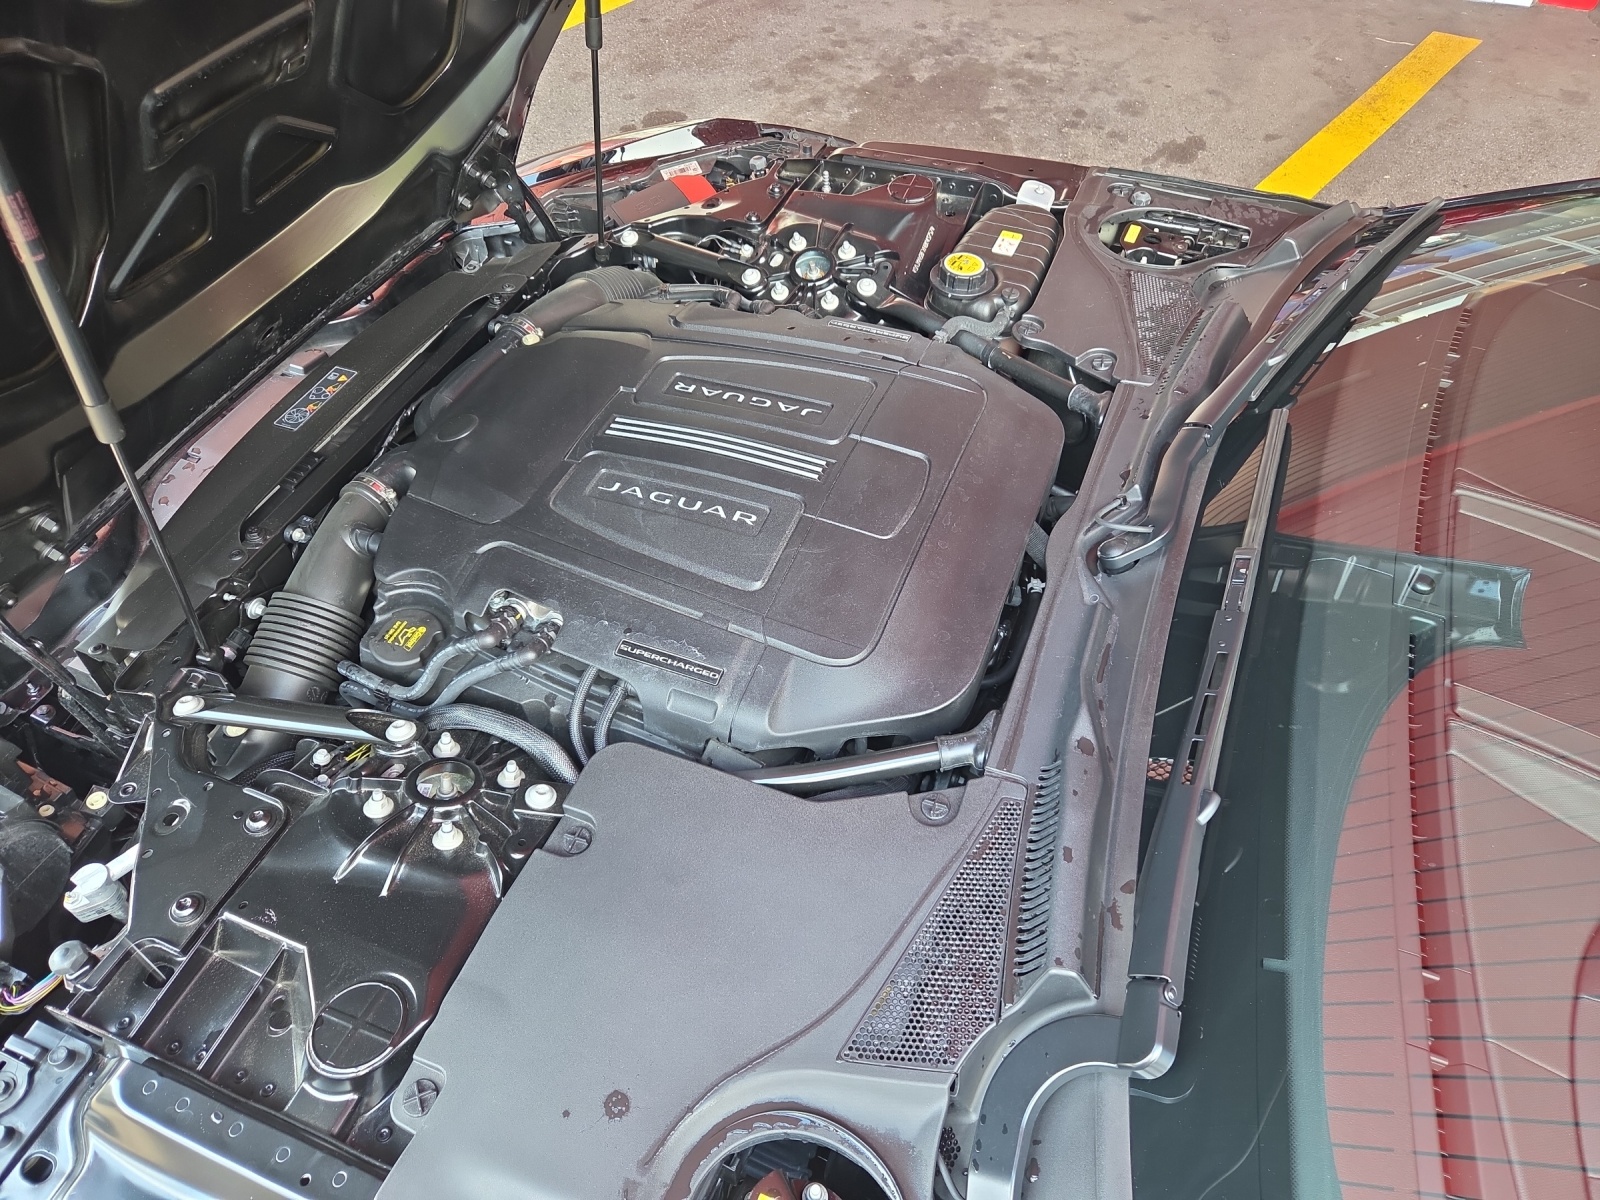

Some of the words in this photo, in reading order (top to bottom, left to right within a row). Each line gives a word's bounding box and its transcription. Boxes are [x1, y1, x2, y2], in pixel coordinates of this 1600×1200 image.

[674, 381, 823, 416] JAGUAR
[597, 482, 758, 526] JAGUAR
[619, 643, 720, 680] SUPERCHARGED
